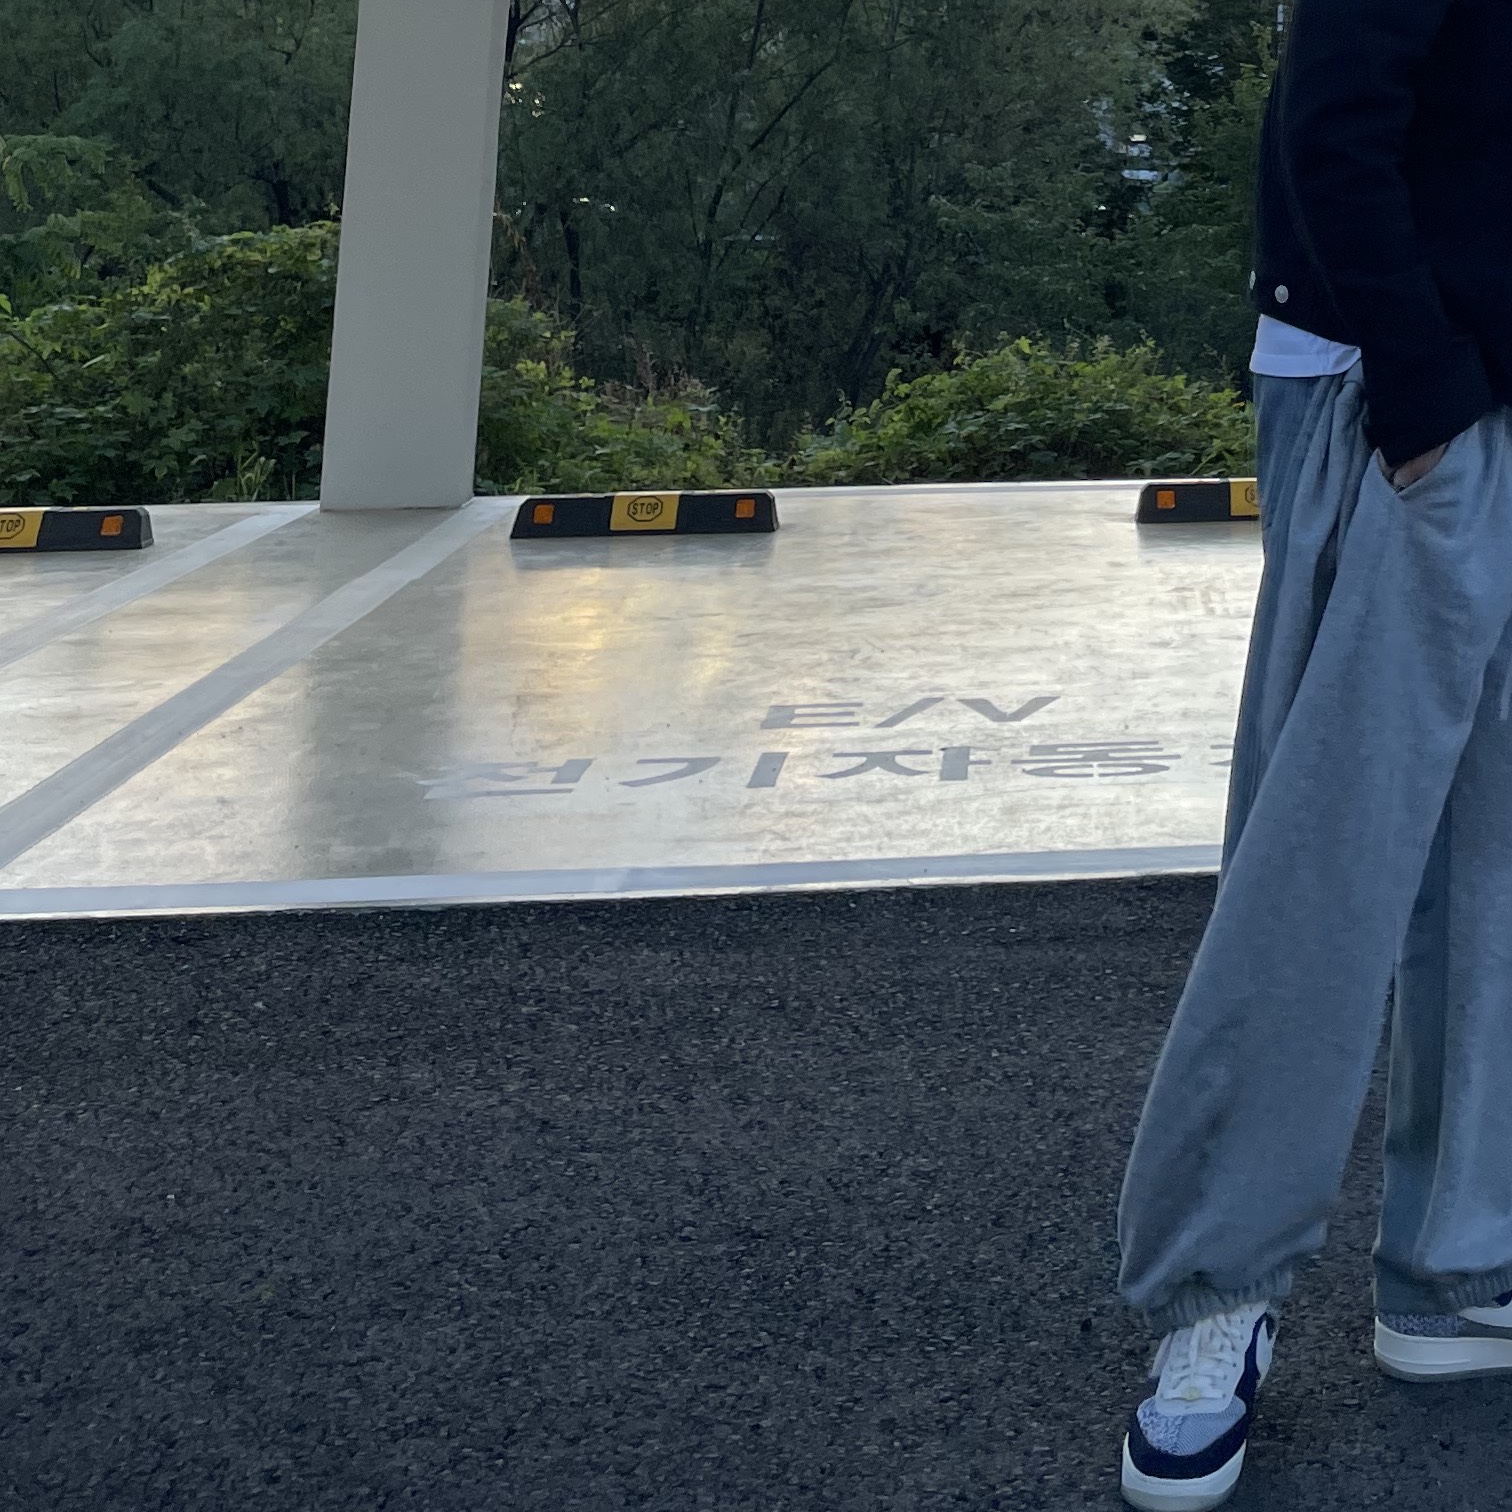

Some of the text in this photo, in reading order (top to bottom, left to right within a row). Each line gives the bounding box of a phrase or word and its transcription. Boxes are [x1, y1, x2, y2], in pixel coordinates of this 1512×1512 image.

[631, 502, 660, 516] STOP
[760, 696, 1061, 729] E/V
[415, 740, 1234, 800] 전기자동
